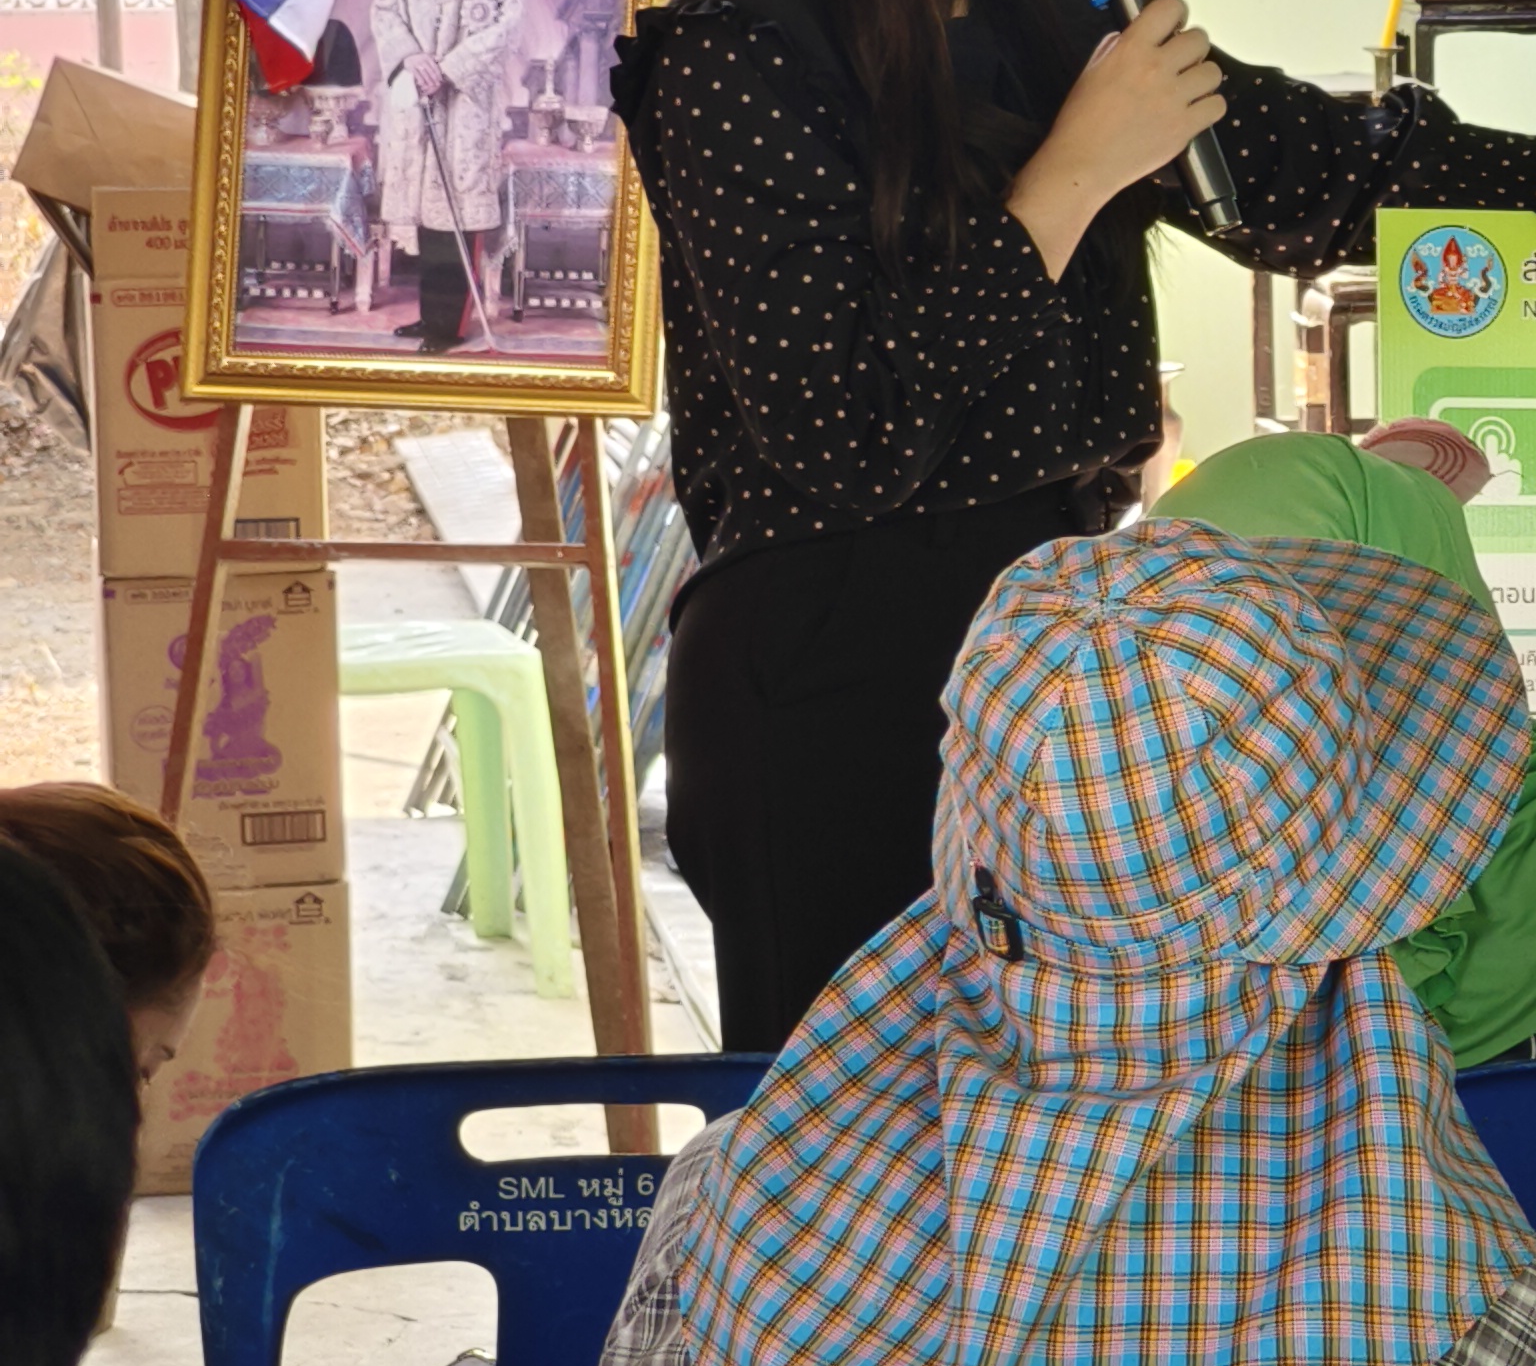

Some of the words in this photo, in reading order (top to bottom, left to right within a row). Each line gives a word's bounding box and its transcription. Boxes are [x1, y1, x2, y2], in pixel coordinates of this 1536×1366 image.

[499, 1176, 566, 1200] SML
[577, 1168, 624, 1206] หมู่
[636, 1173, 655, 1195] 6
[458, 1200, 654, 1232] ตำบลบางหล
